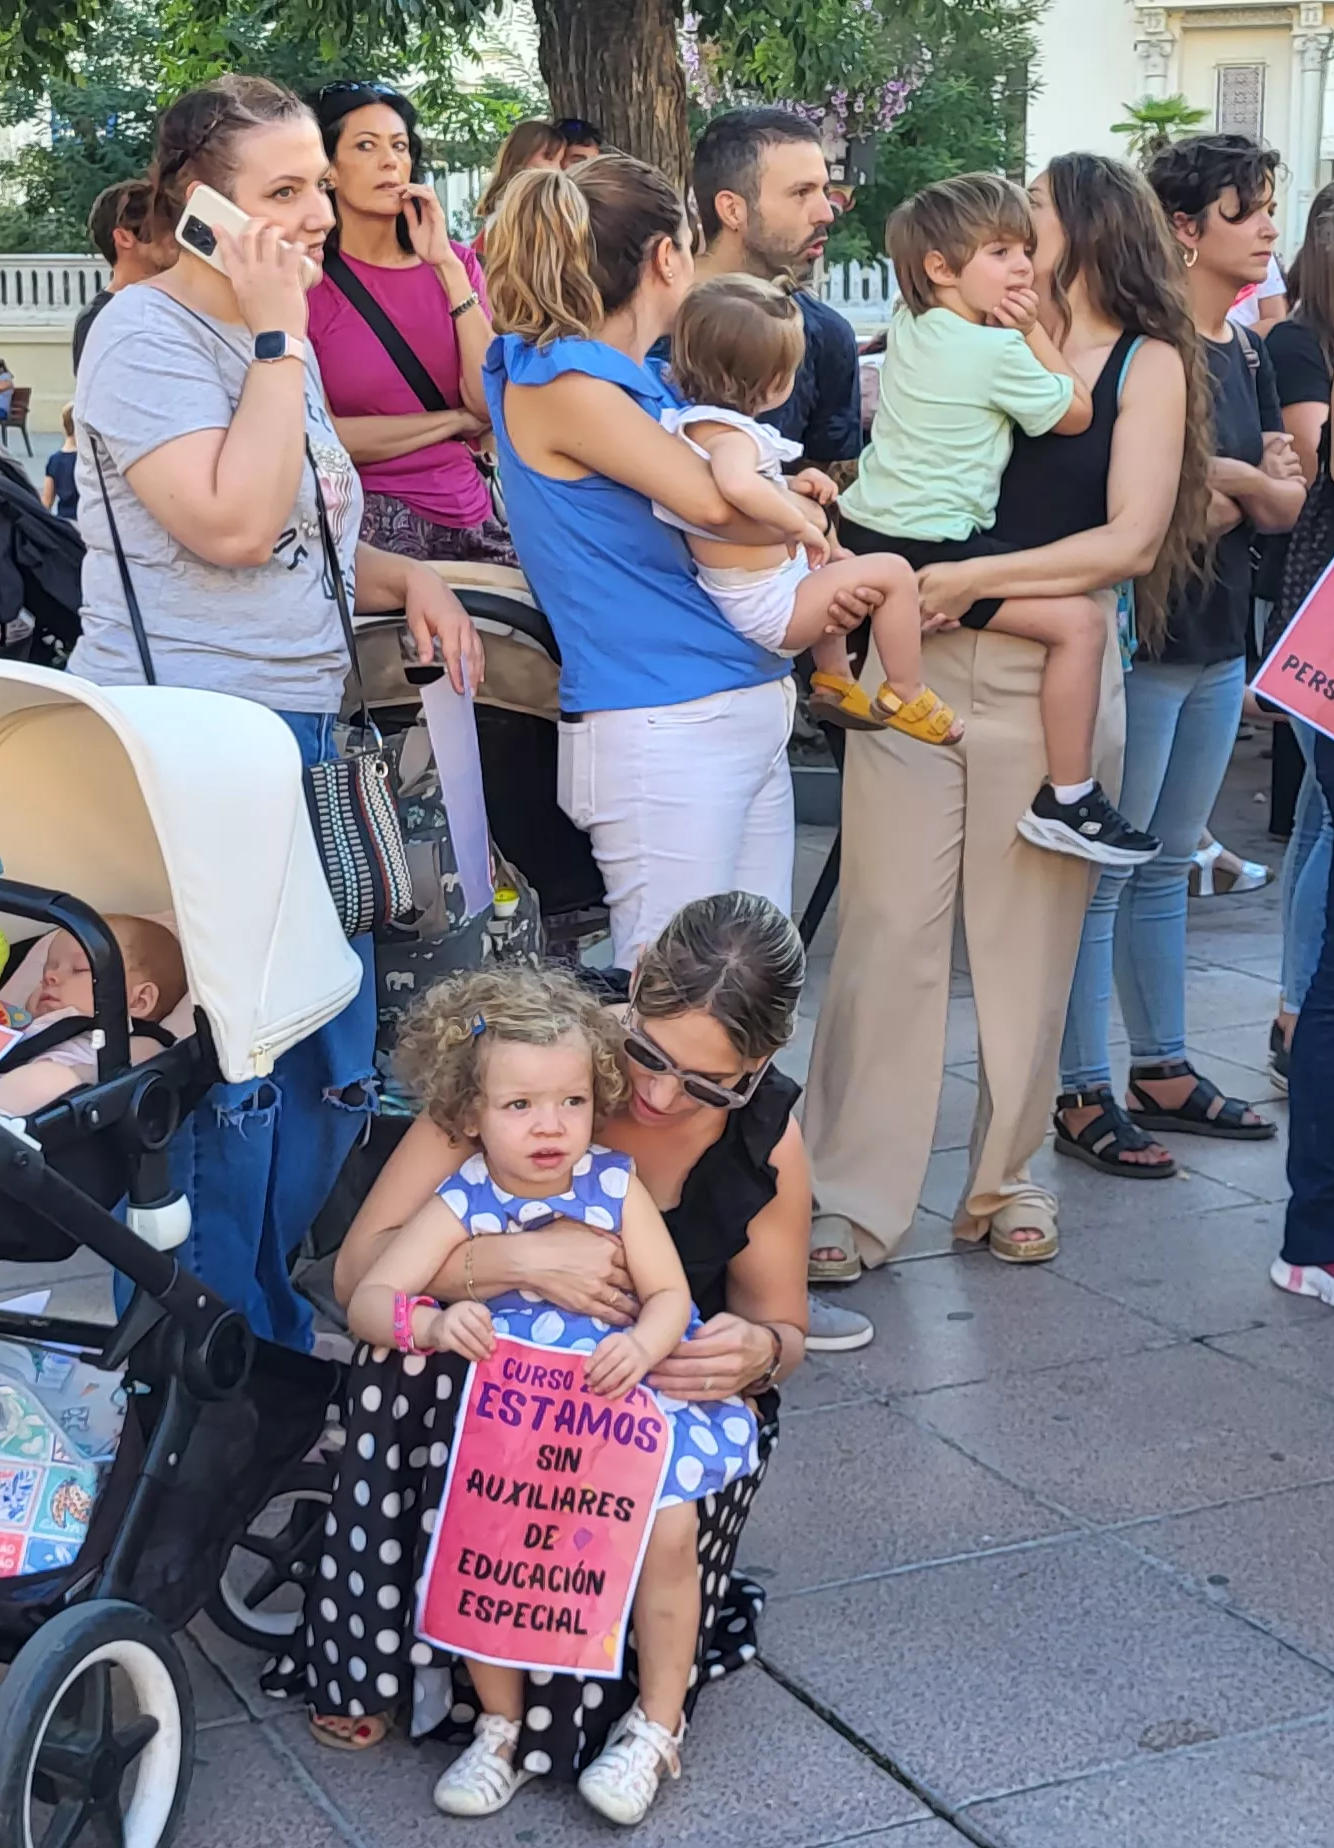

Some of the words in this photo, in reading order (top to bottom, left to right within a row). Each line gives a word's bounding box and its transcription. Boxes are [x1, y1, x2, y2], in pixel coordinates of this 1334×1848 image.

[503, 1357, 574, 1391] CURSO
[476, 1381, 662, 1453] ESTAMOS
[536, 1445, 582, 1473] SIN
[467, 1469, 635, 1522] AUXILIARES
[523, 1523, 559, 1550] DE
[457, 1548, 606, 1596] EDUCACIÓN
[457, 1590, 588, 1635] ESPECIAL
